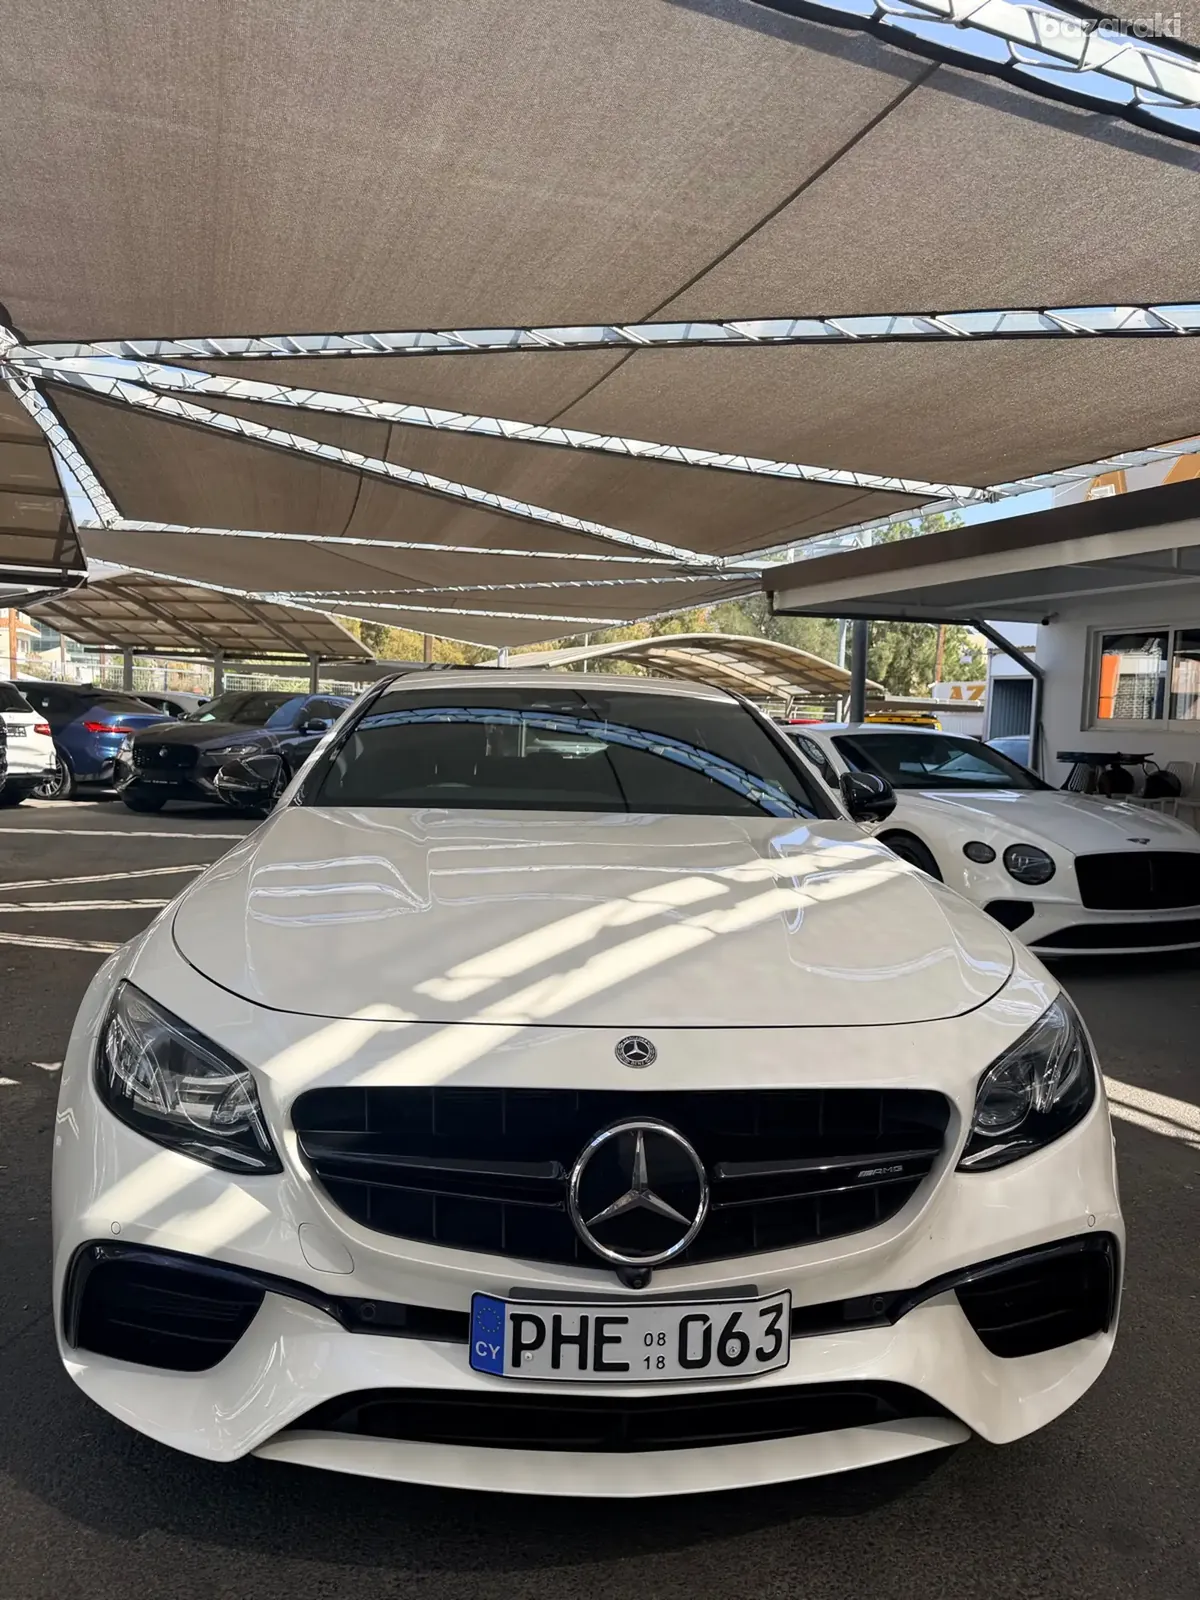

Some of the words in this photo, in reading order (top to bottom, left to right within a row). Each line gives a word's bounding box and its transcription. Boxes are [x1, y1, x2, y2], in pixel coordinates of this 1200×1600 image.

[510, 1313, 629, 1372] PHE
[678, 1303, 784, 1370] 063
[644, 1332, 666, 1347] 08
[475, 1341, 500, 1360] CY
[644, 1356, 666, 1370] 18
